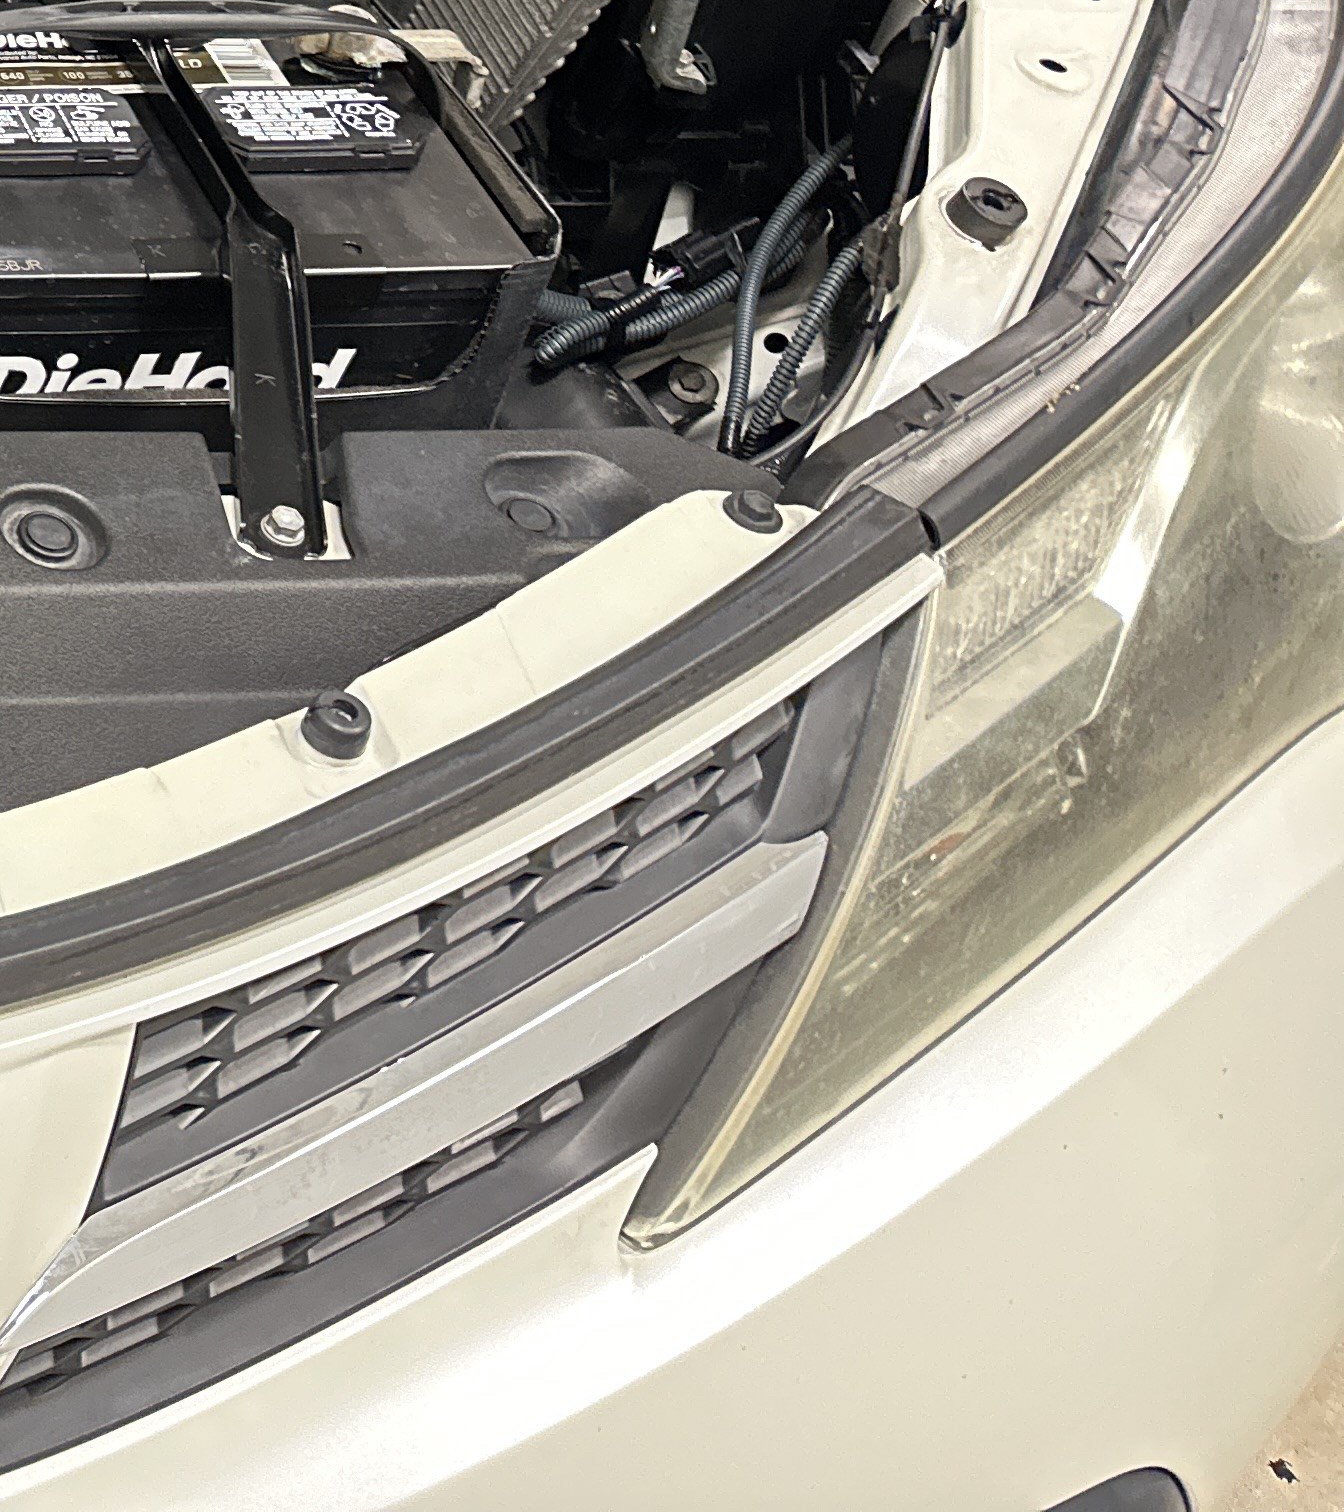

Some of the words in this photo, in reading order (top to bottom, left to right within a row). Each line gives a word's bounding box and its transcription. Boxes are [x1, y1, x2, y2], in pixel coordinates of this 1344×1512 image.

[178, 58, 202, 69] LD
[0, 71, 25, 81] 640
[62, 71, 86, 80] 100
[45, 93, 104, 103] POISON
